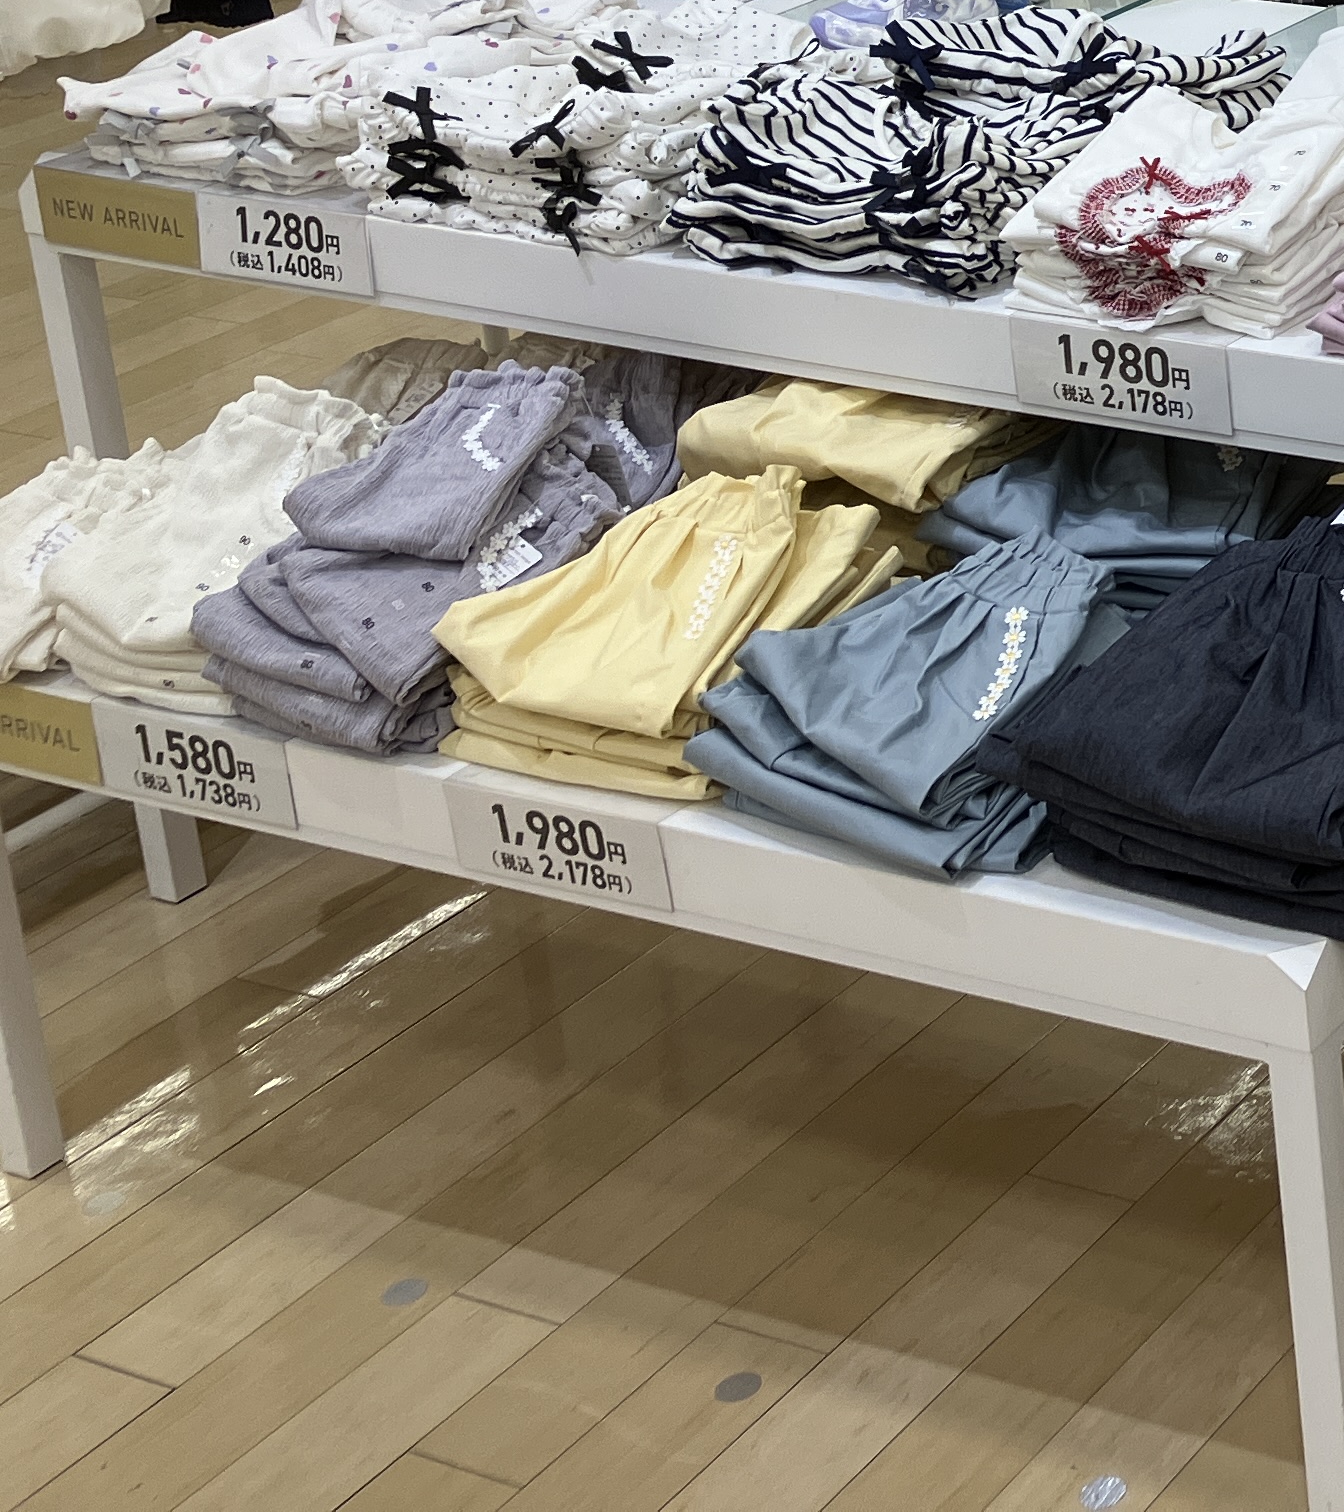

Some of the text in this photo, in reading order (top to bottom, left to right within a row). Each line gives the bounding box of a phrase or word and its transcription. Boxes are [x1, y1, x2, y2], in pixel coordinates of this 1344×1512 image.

[53, 197, 185, 242] NEW ARRIVAL
[235, 206, 341, 257] 1,280円
[1215, 252, 1229, 263] 80
[1058, 334, 1191, 392] 1,980円
[361, 617, 376, 630] 80
[135, 724, 256, 785] 1,580円
[491, 803, 627, 866] 1,980円
